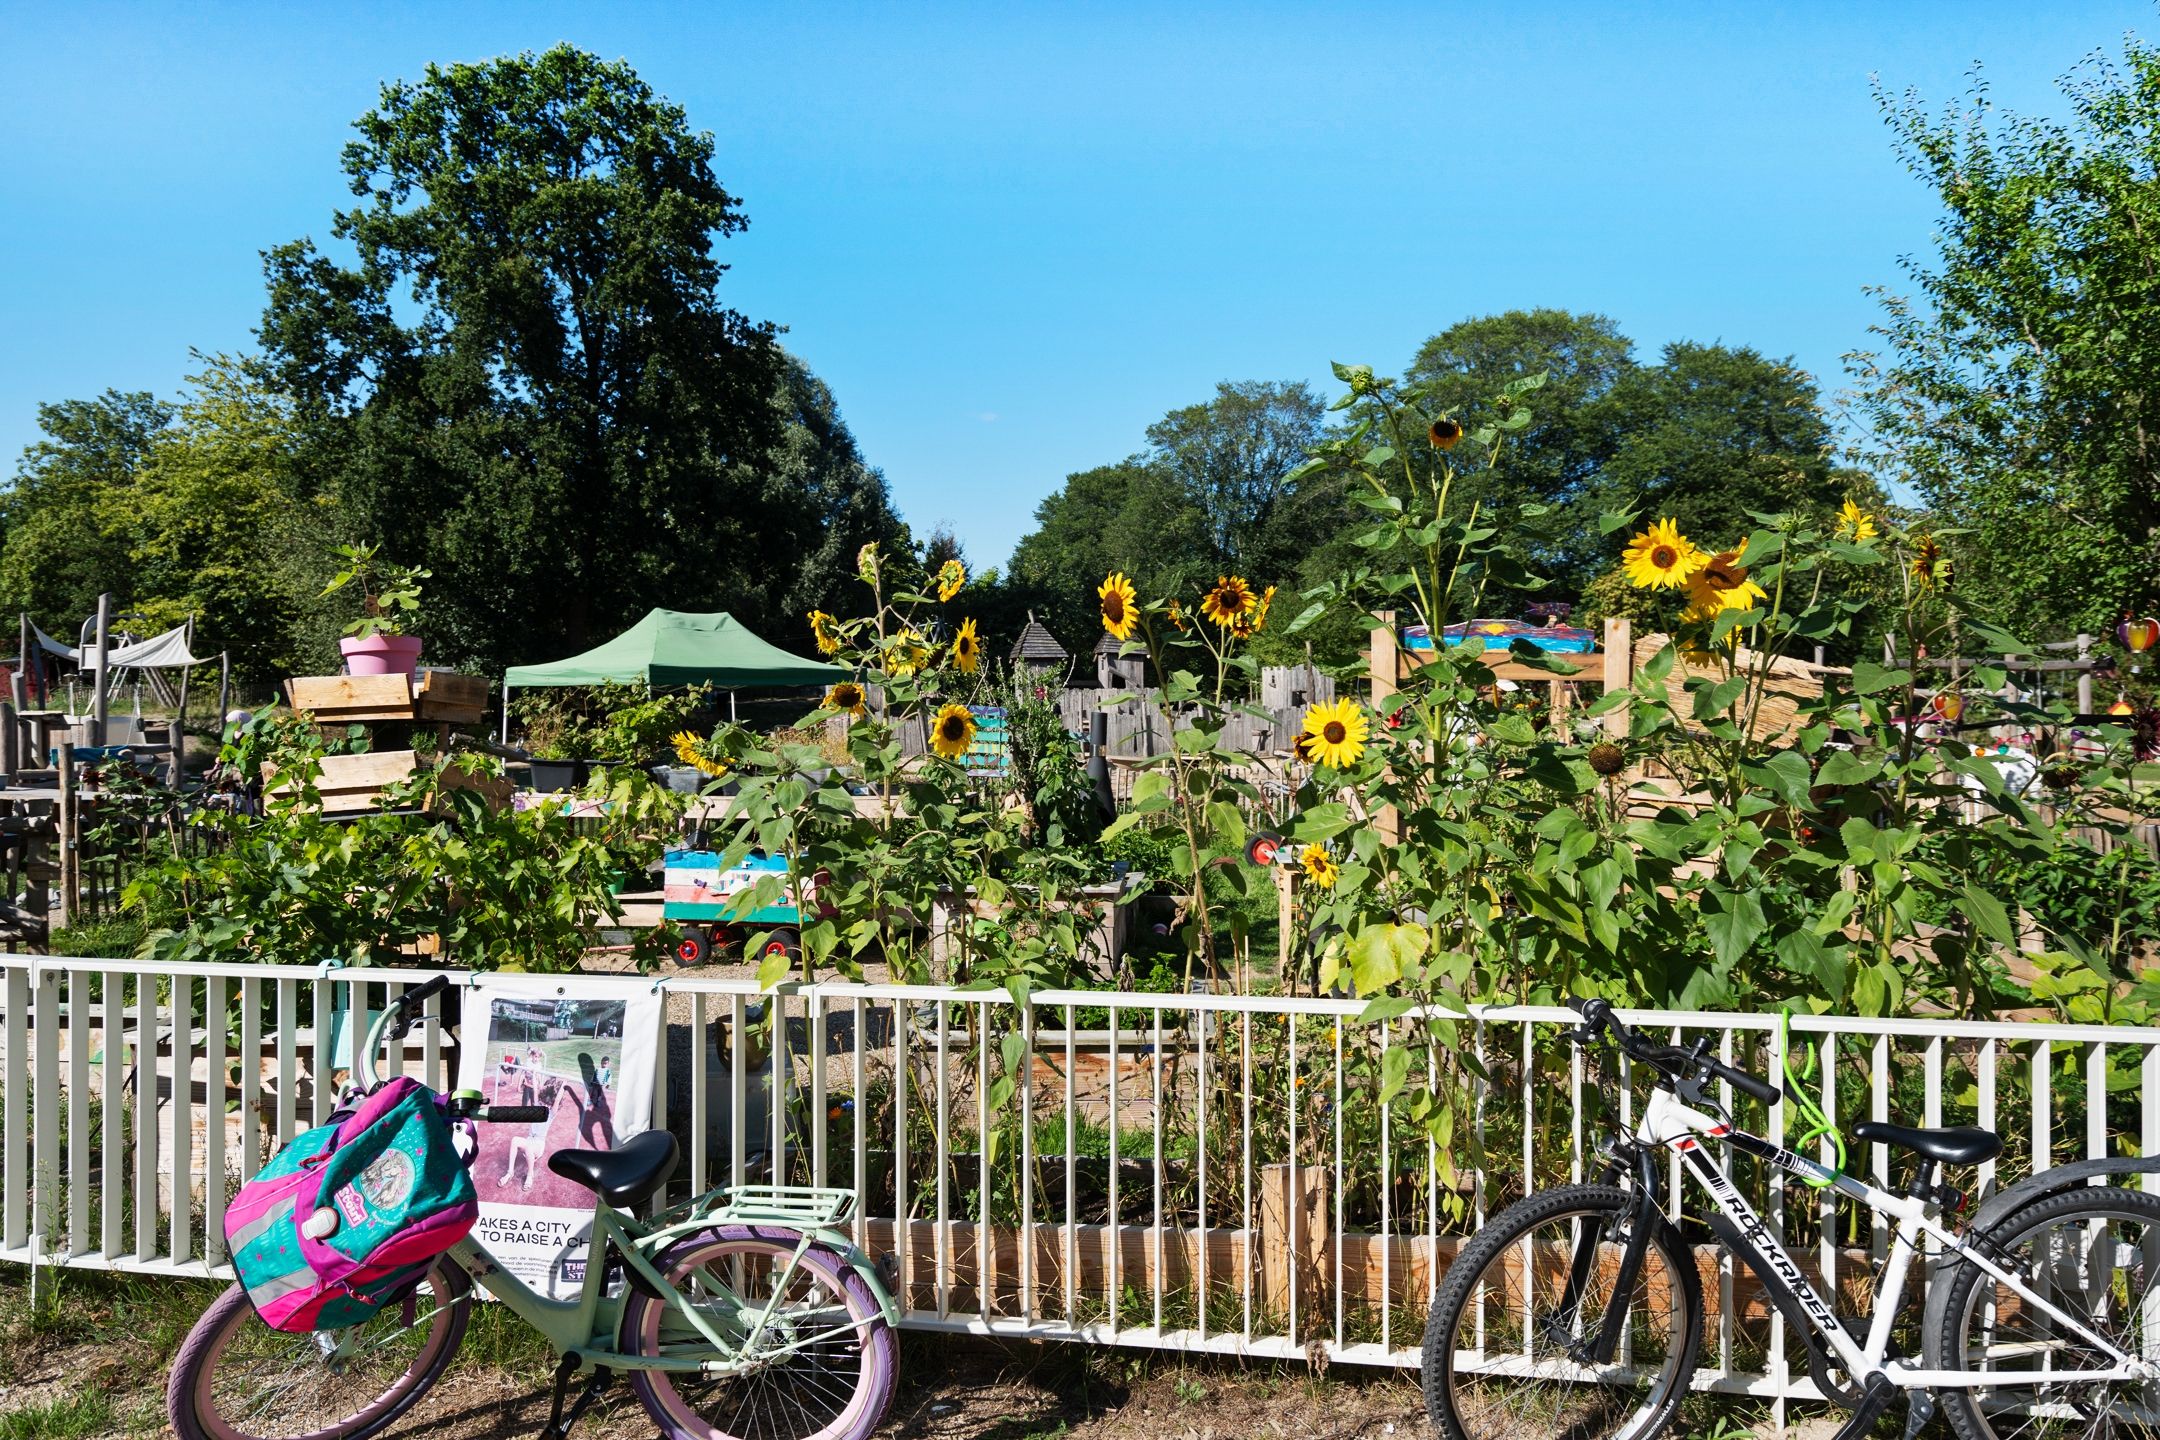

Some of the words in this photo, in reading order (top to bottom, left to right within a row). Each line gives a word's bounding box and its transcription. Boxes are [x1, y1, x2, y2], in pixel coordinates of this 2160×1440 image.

[479, 1216, 518, 1231] AKES
[521, 1220, 532, 1231] A
[535, 1221, 571, 1234] CITY
[480, 1230, 501, 1242] TO
[504, 1232, 549, 1246] RAISE
[552, 1236, 563, 1247] A
[1725, 1196, 1838, 1332] ROCKRIDER
